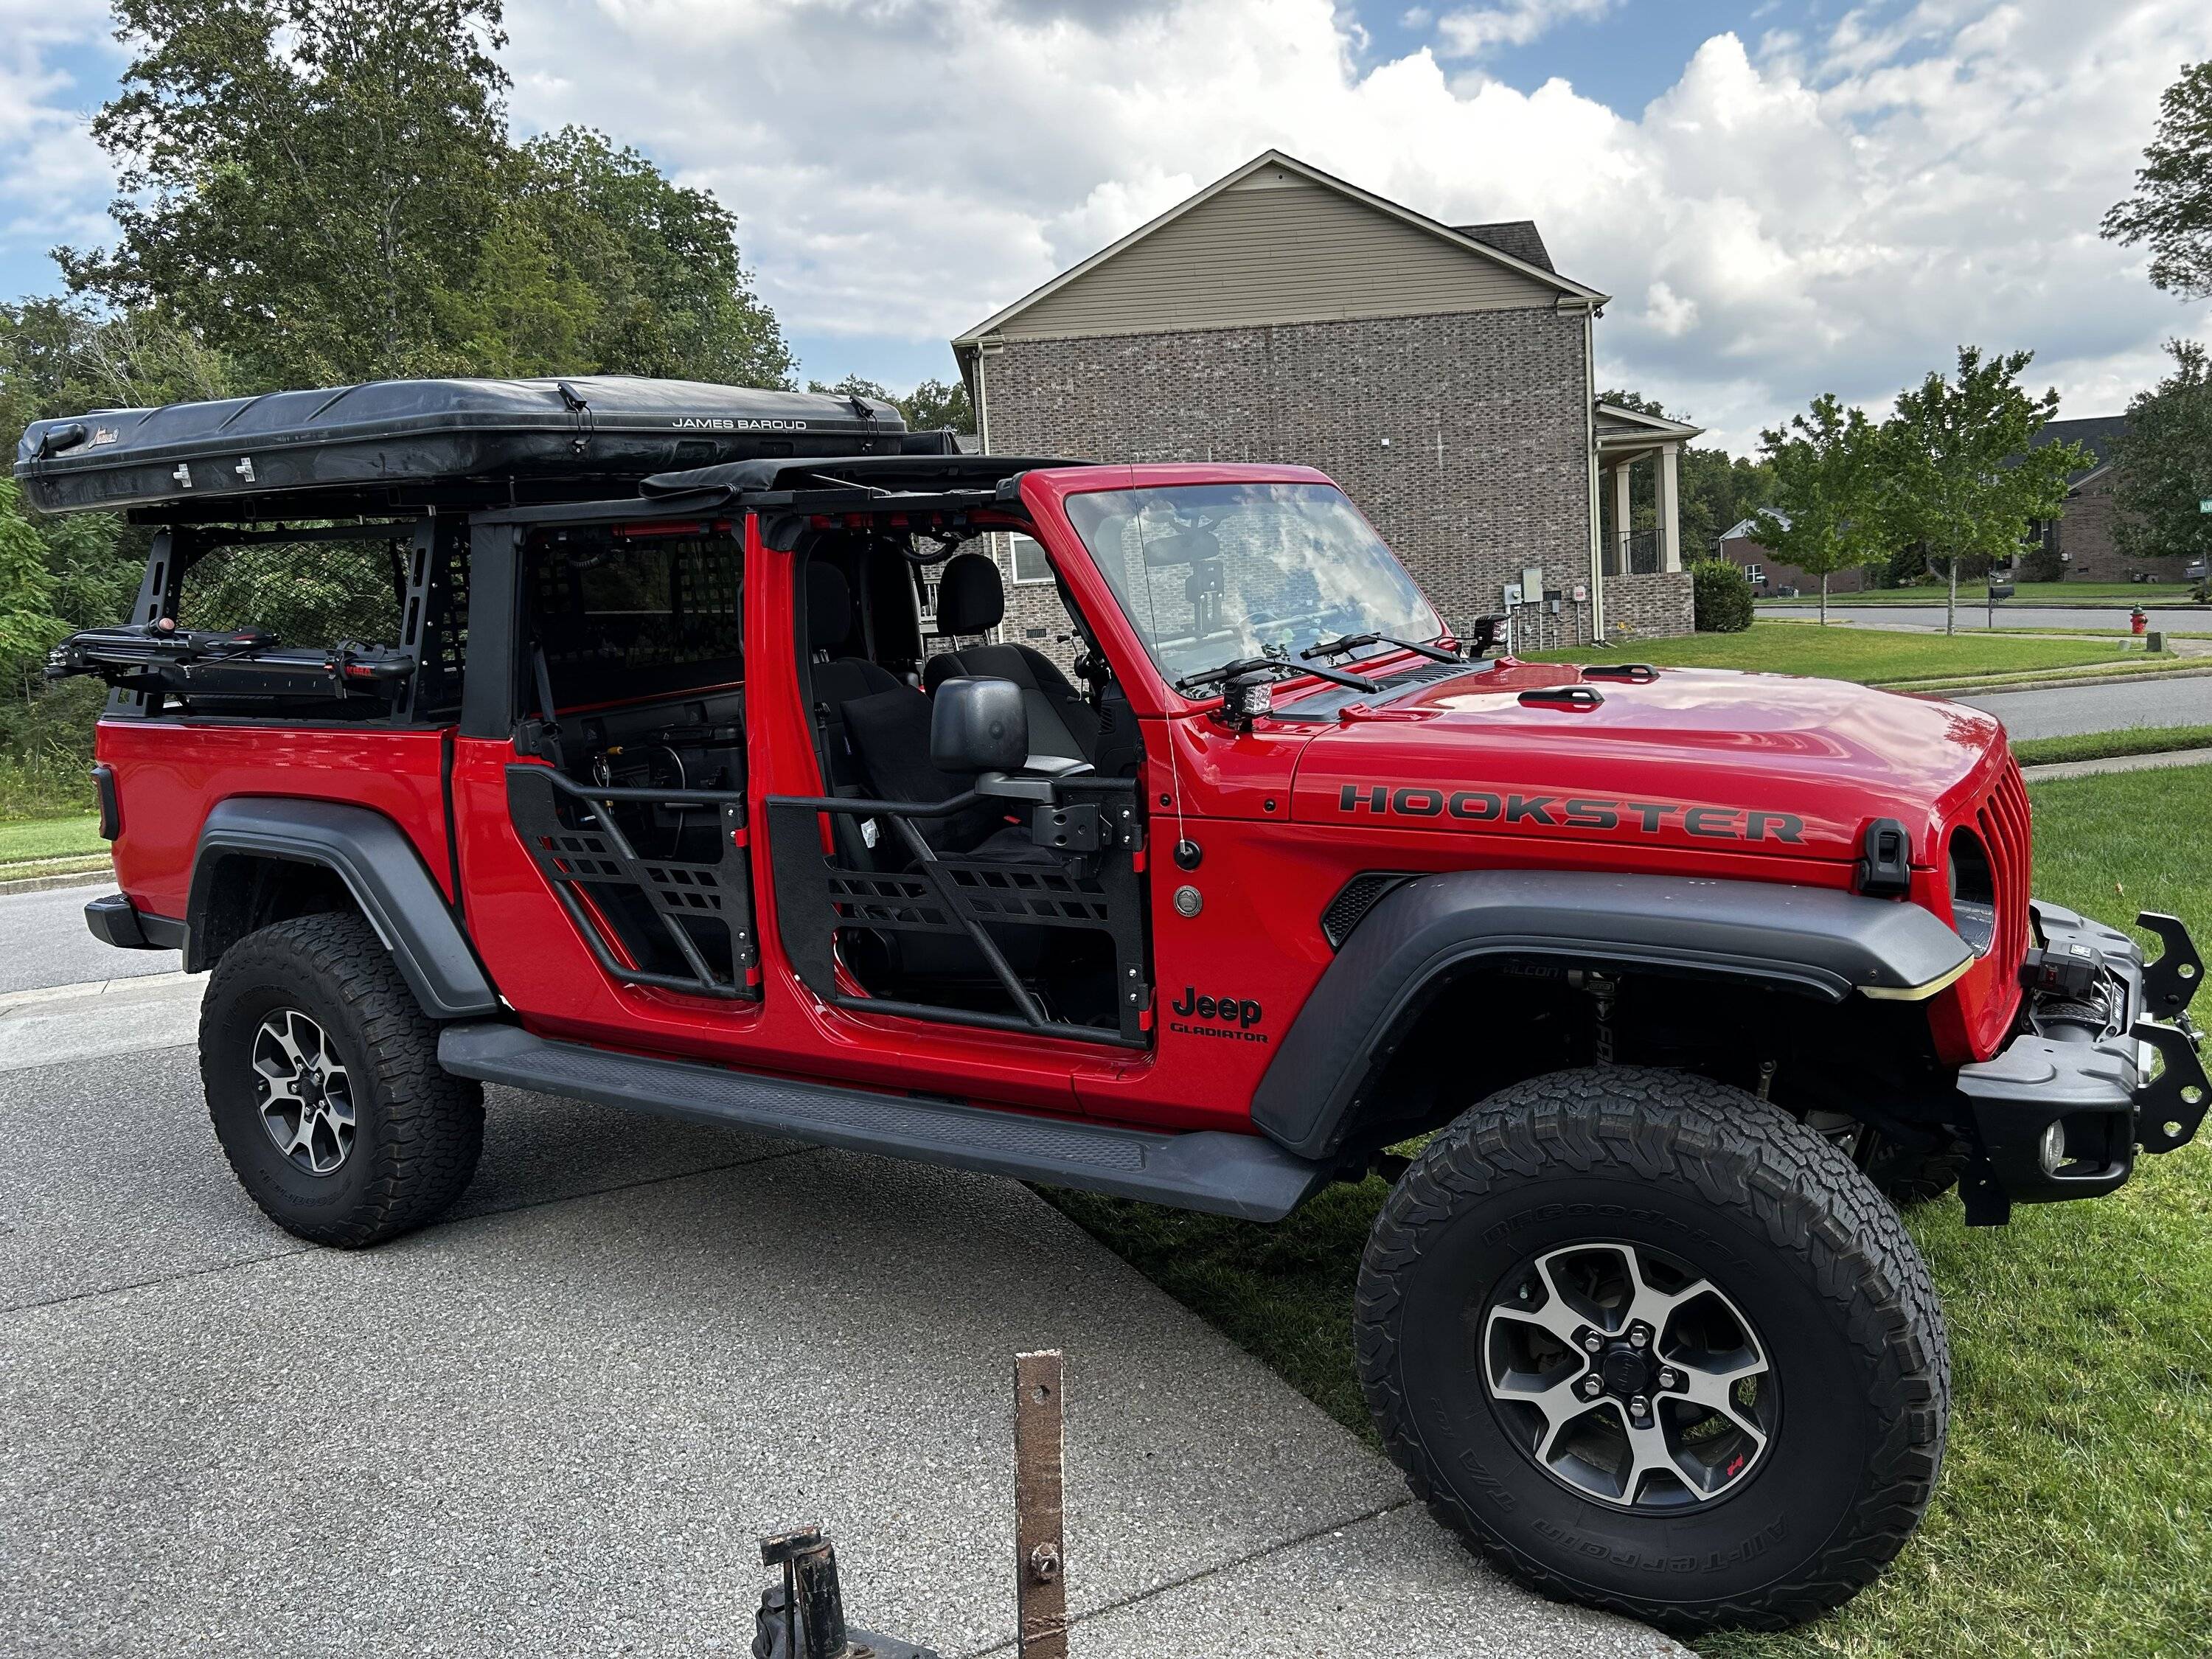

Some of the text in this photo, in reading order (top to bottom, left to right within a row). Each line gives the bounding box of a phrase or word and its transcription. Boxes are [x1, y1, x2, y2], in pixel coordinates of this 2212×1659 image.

[672, 418, 807, 430] JAMES BAROUD
[1338, 785, 1809, 846] HOOKSTER
[1172, 986, 1262, 1029] Jeep
[1169, 1022, 1269, 1043] GLADIATOR
